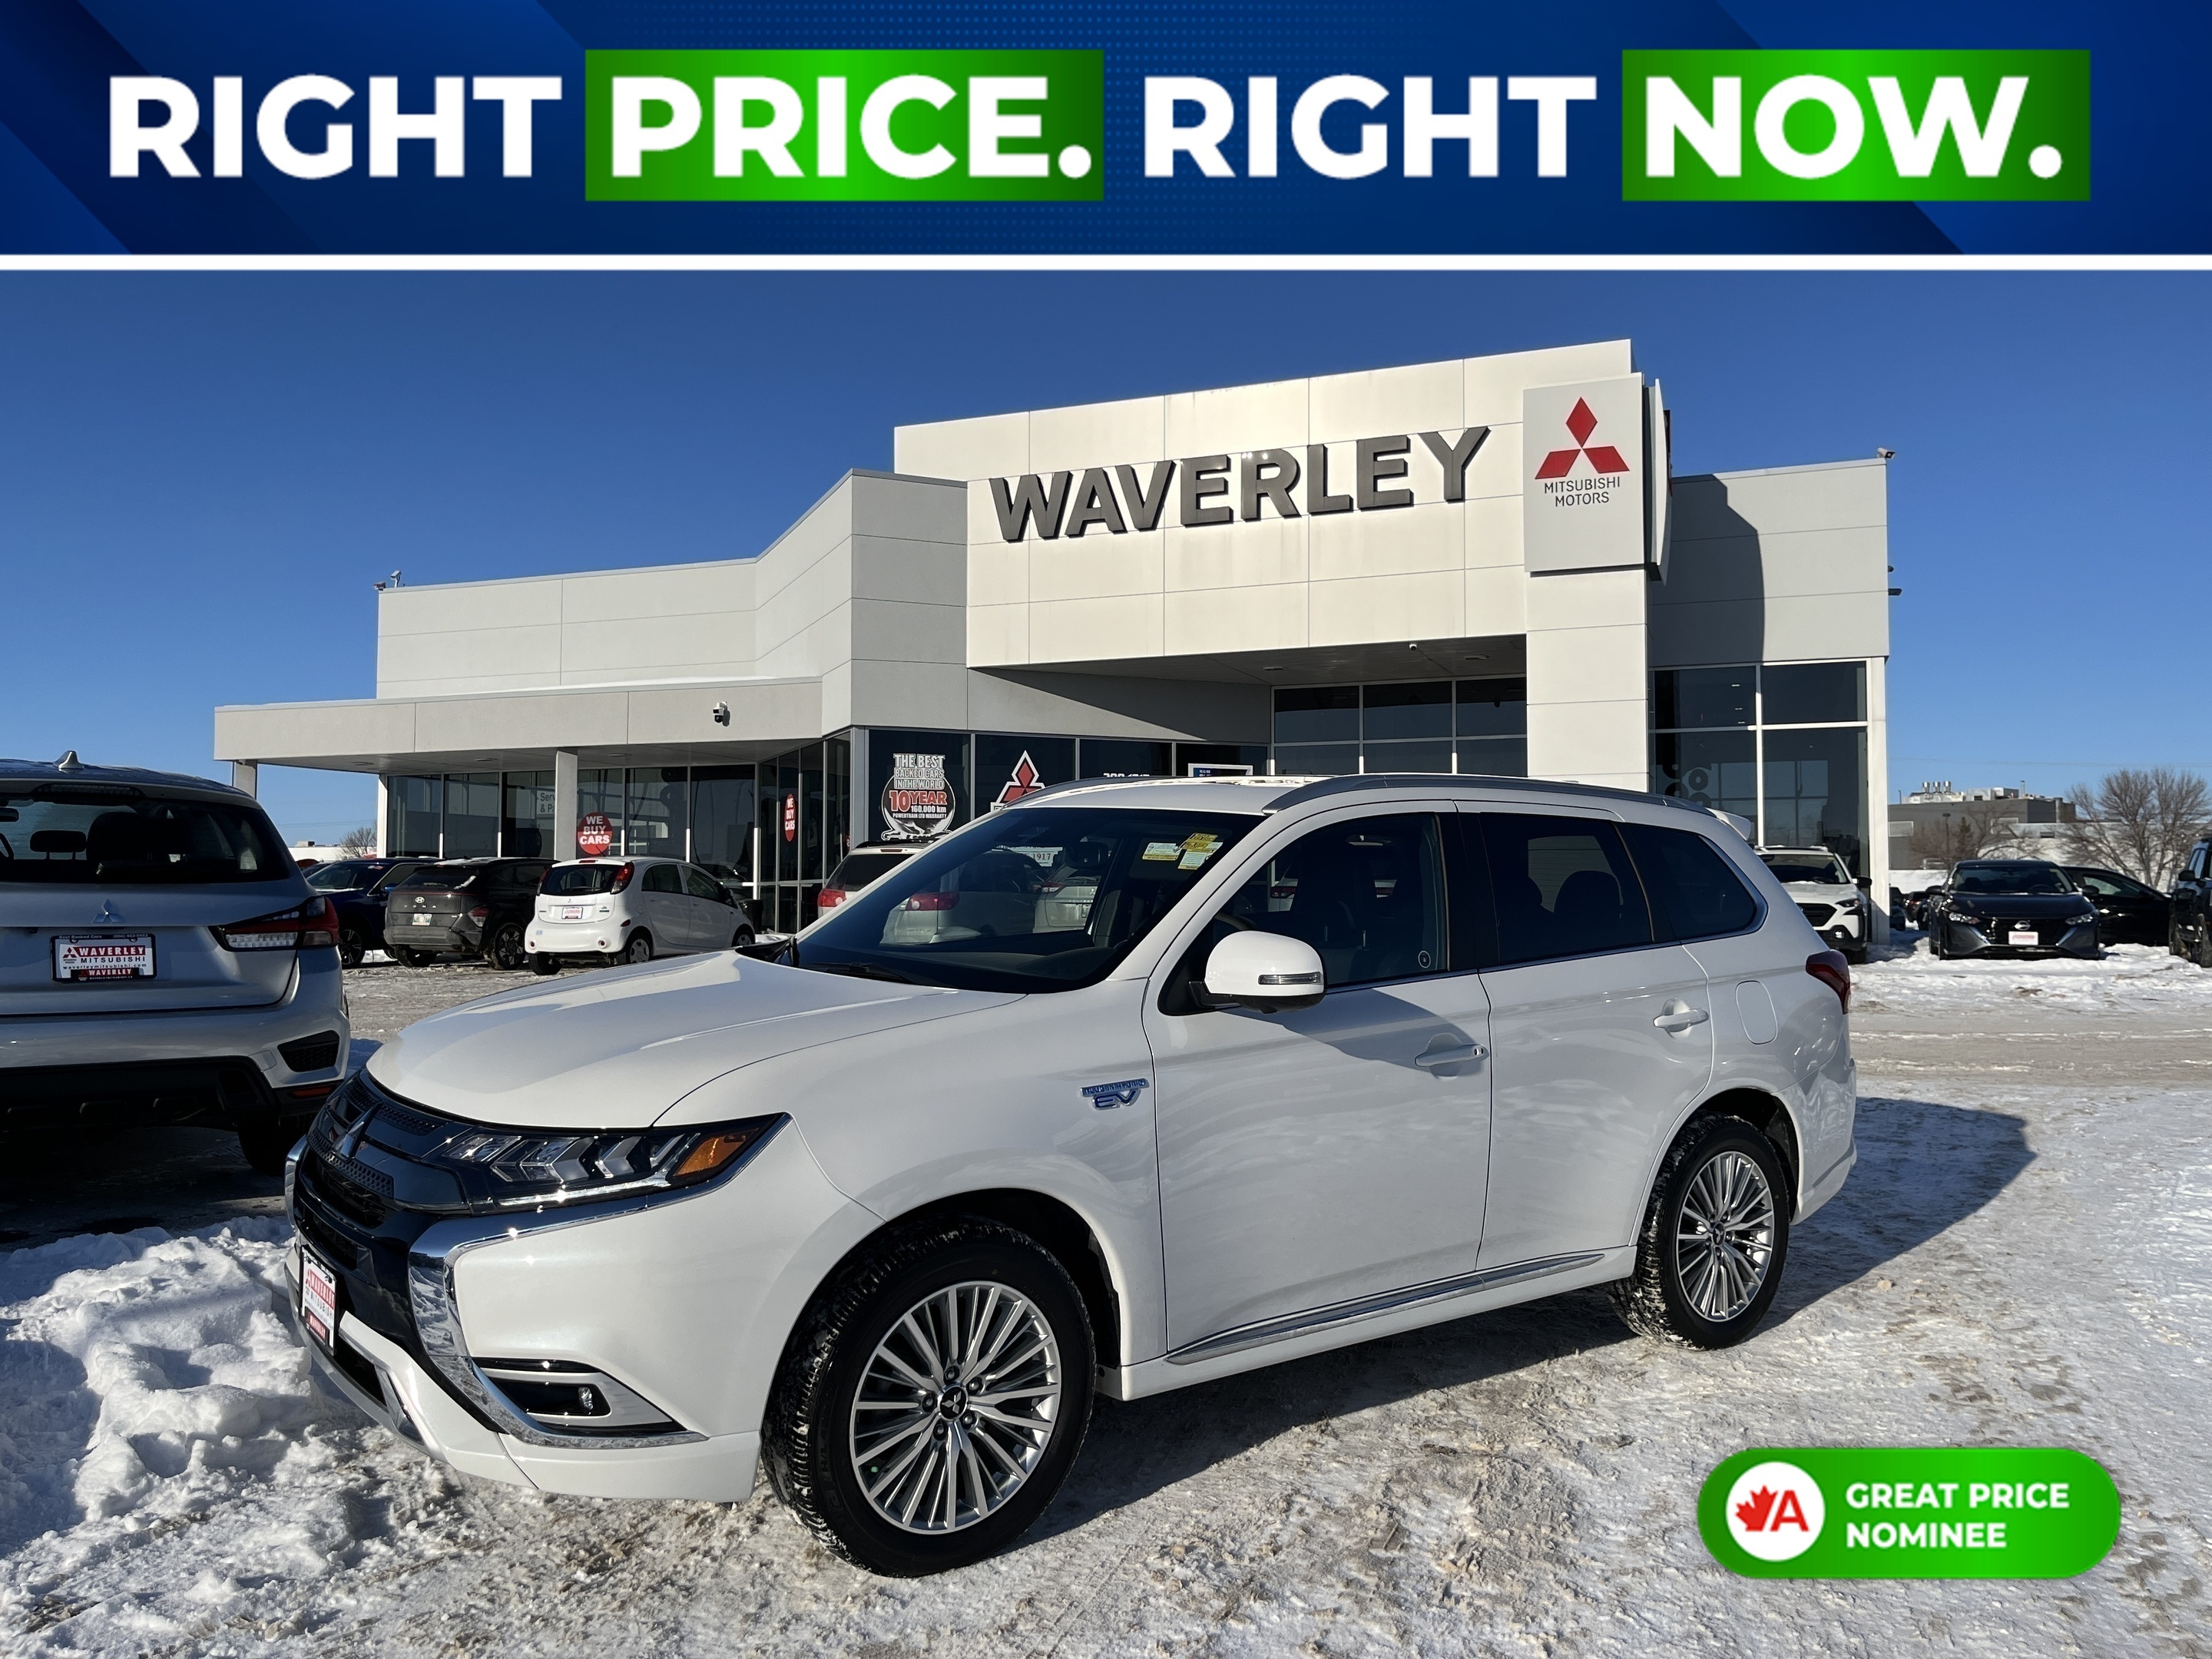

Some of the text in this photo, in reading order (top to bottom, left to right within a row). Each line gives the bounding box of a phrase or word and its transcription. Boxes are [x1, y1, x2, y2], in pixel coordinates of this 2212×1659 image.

[989, 426, 1491, 543] WAVERLEY
[1545, 476, 1620, 493] MITSUBISHI
[1555, 492, 1609, 507] MOTORS
[893, 753, 945, 768] THE BEST
[895, 768, 945, 779] BACKED CARS
[895, 778, 944, 789] IN THE WORLD
[787, 798, 793, 808] WE
[889, 790, 948, 812] 10 YEAR
[936, 805, 946, 813] km
[586, 816, 603, 825] WE
[785, 820, 795, 830] CARS
[583, 826, 606, 835] BUY
[579, 835, 610, 845] CARS
[79, 947, 144, 956] WAVERLEY
[1094, 1089, 1141, 1110] EV
[311, 1272, 335, 1308] WAVERLEY
[310, 1313, 326, 1339] WAVERLEY
